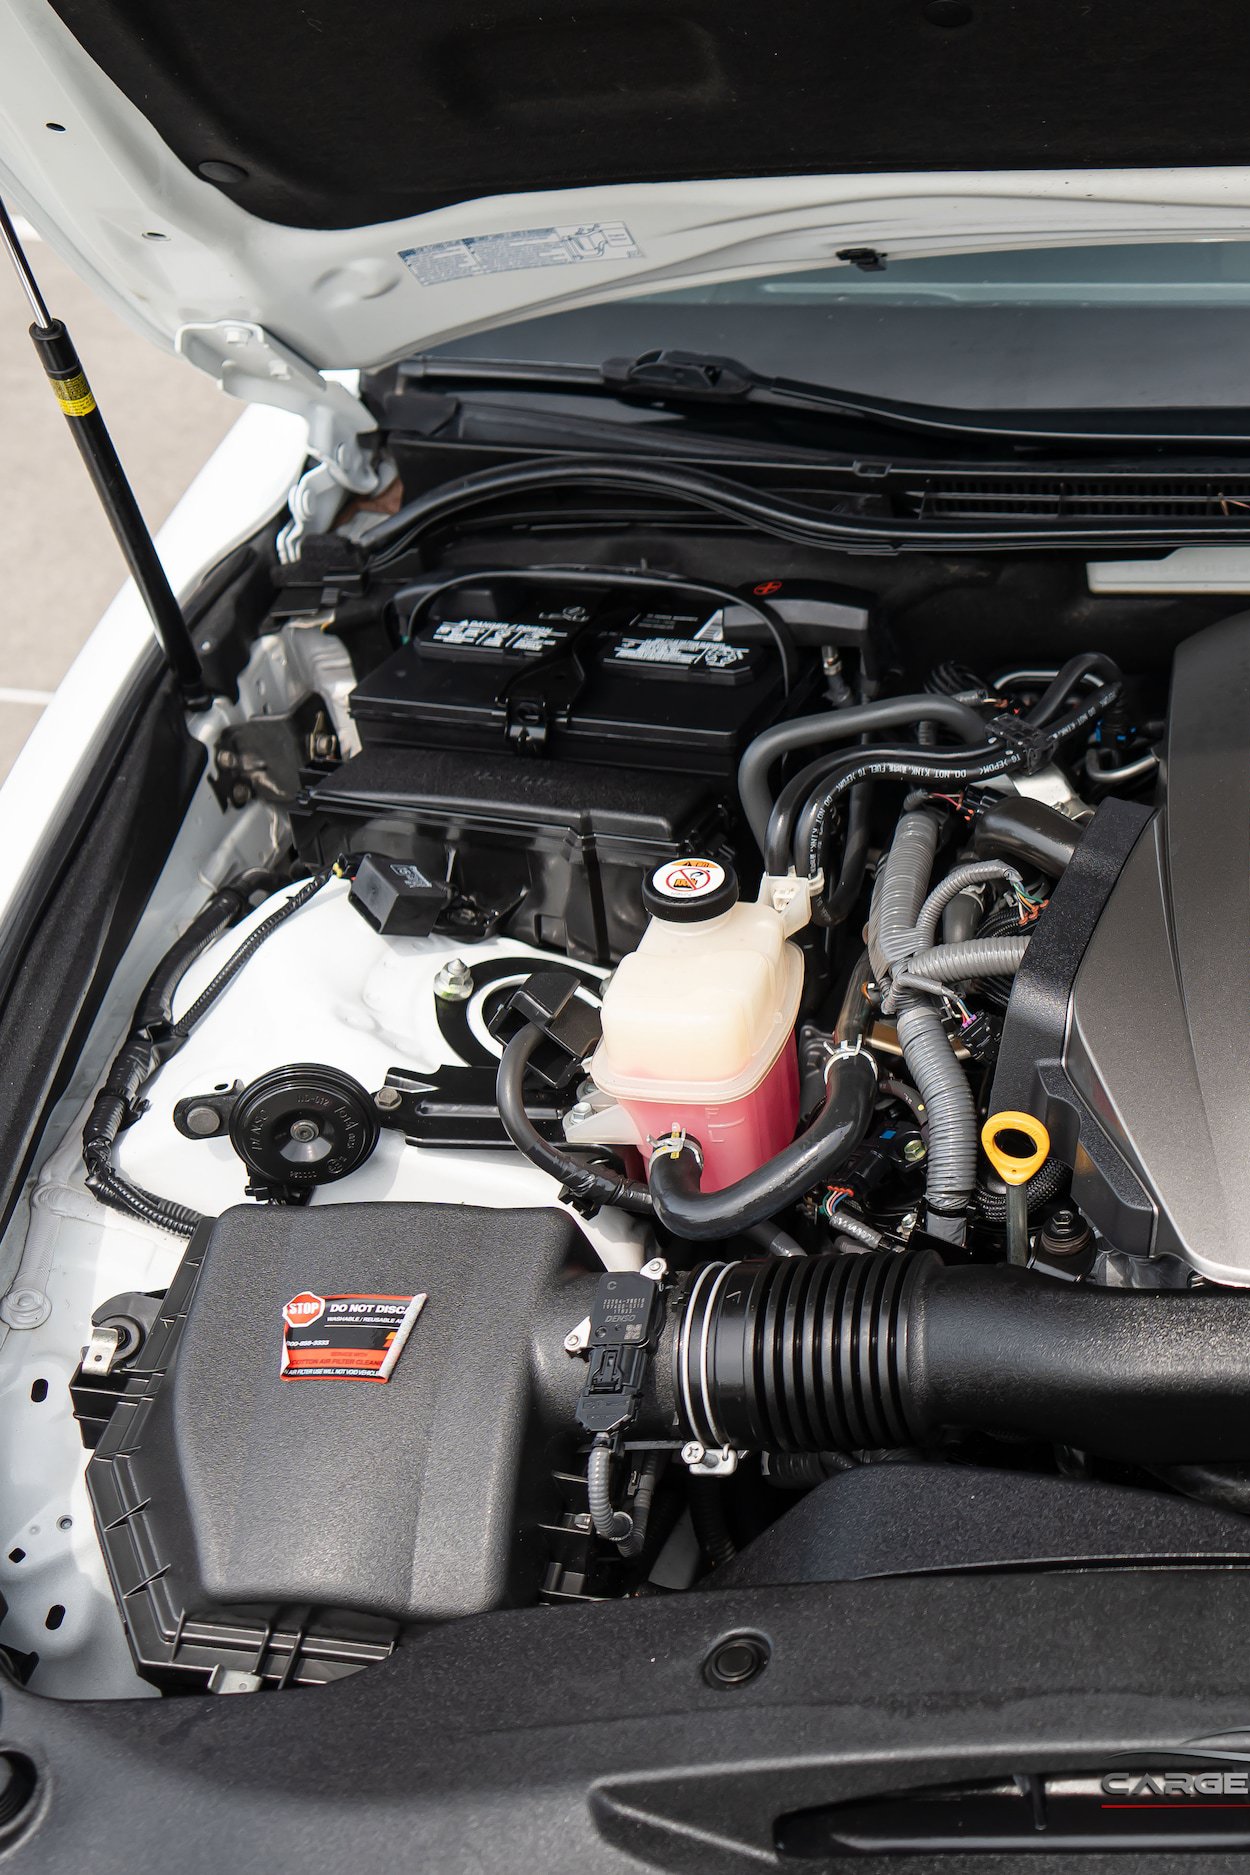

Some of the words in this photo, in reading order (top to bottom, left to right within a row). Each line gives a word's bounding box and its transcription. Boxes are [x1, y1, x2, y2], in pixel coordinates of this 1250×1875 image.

[606, 1280, 617, 1290] C
[289, 1302, 319, 1315] STOP
[329, 1303, 348, 1313] DO
[349, 1304, 374, 1313] NOT
[604, 1314, 637, 1323] DENSO
[332, 1358, 355, 1366] FILTER
